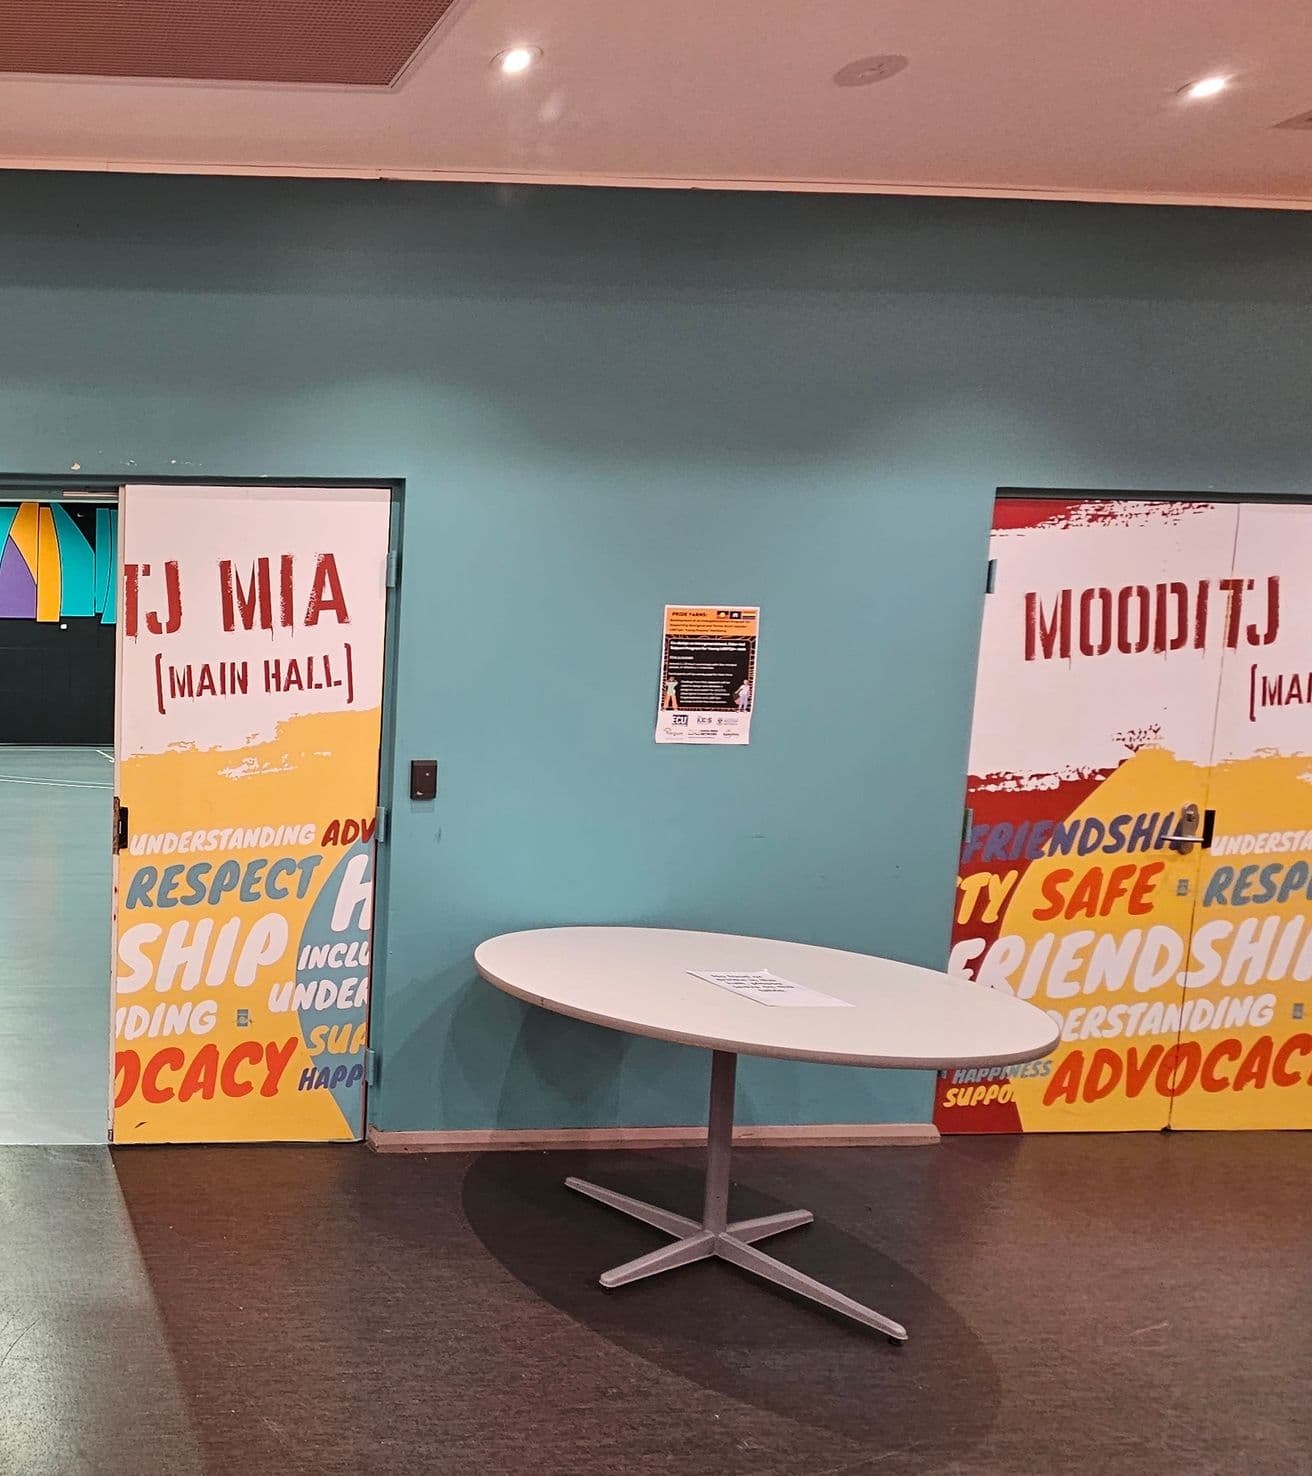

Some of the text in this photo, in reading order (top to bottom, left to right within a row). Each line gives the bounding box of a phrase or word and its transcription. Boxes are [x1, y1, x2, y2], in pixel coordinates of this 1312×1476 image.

[219, 553, 351, 632] MIA
[1024, 575, 1281, 663] MOODITJ
[129, 823, 317, 856] UNDERSTANDING
[125, 854, 324, 910] RESPECT
[955, 869, 1019, 925] TY
[1032, 861, 1166, 921] SAFE
[1202, 860, 1312, 908] RESP
[117, 912, 289, 994] SHIP
[297, 1063, 364, 1091] HAPP
[942, 1083, 1017, 1108] SUPPO
[952, 1060, 1053, 1085] HAPPINESS
[1042, 1032, 1312, 1107] ADVOCAC
